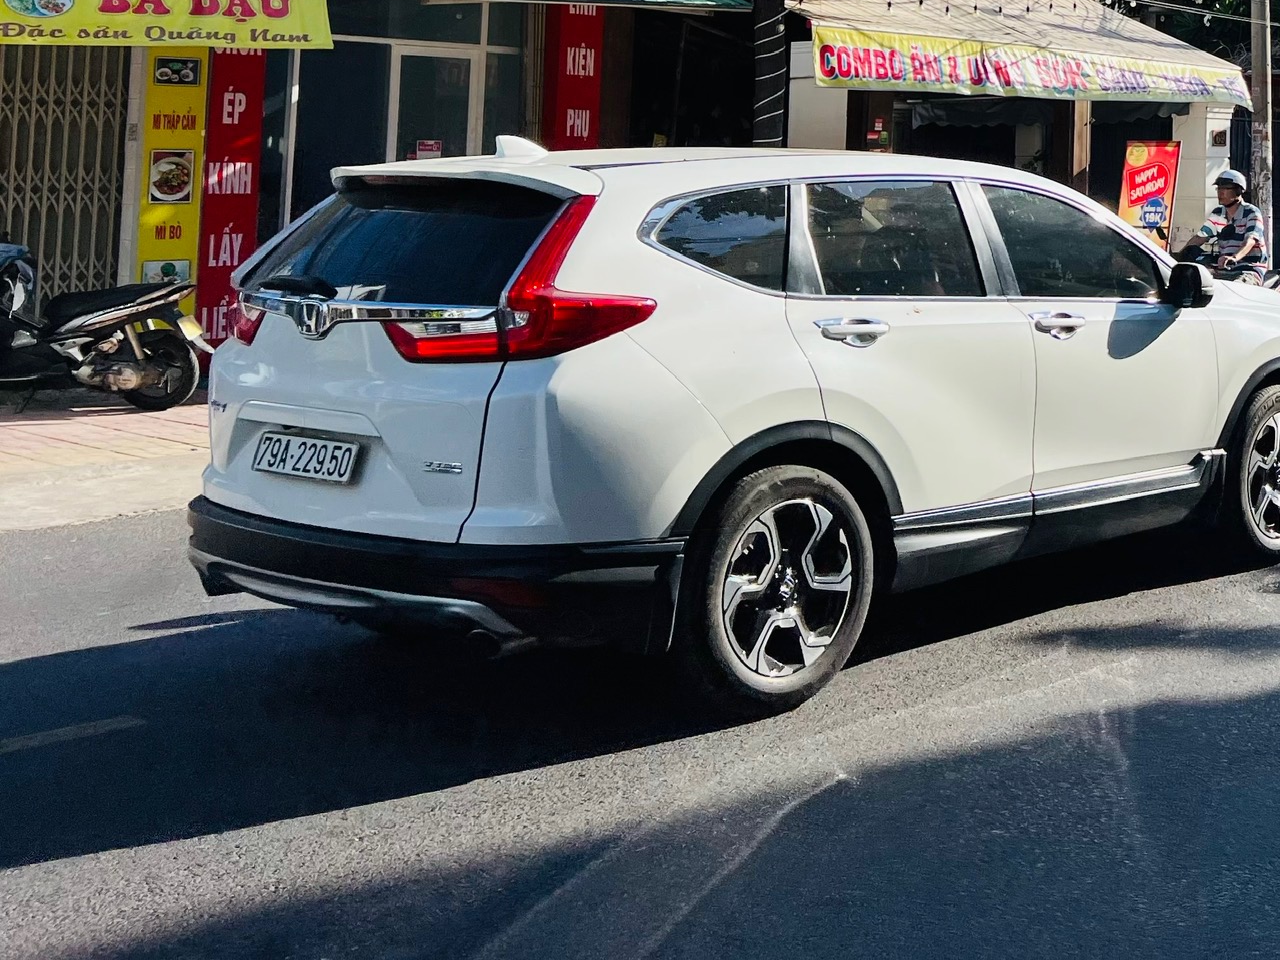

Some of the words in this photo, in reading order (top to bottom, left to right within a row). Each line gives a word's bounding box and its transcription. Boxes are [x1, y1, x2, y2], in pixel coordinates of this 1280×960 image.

[0, 22, 67, 41] Đặc
[76, 25, 133, 40] sản
[144, 24, 236, 44] Quảng
[249, 27, 312, 43] Nam
[566, 43, 595, 79] KIỆN
[819, 44, 906, 82] COMBO
[909, 46, 943, 84] ĂN
[222, 86, 246, 124] ÉP
[566, 109, 590, 141] PHỤ
[208, 156, 253, 194] KÍNH
[1130, 178, 1166, 200] SATURDAY
[1135, 166, 1159, 184] HAPPY
[155, 221, 167, 240] MÌ
[169, 221, 182, 240] BÒ
[1145, 212, 1162, 223] 19K
[208, 222, 243, 267] LẤY
